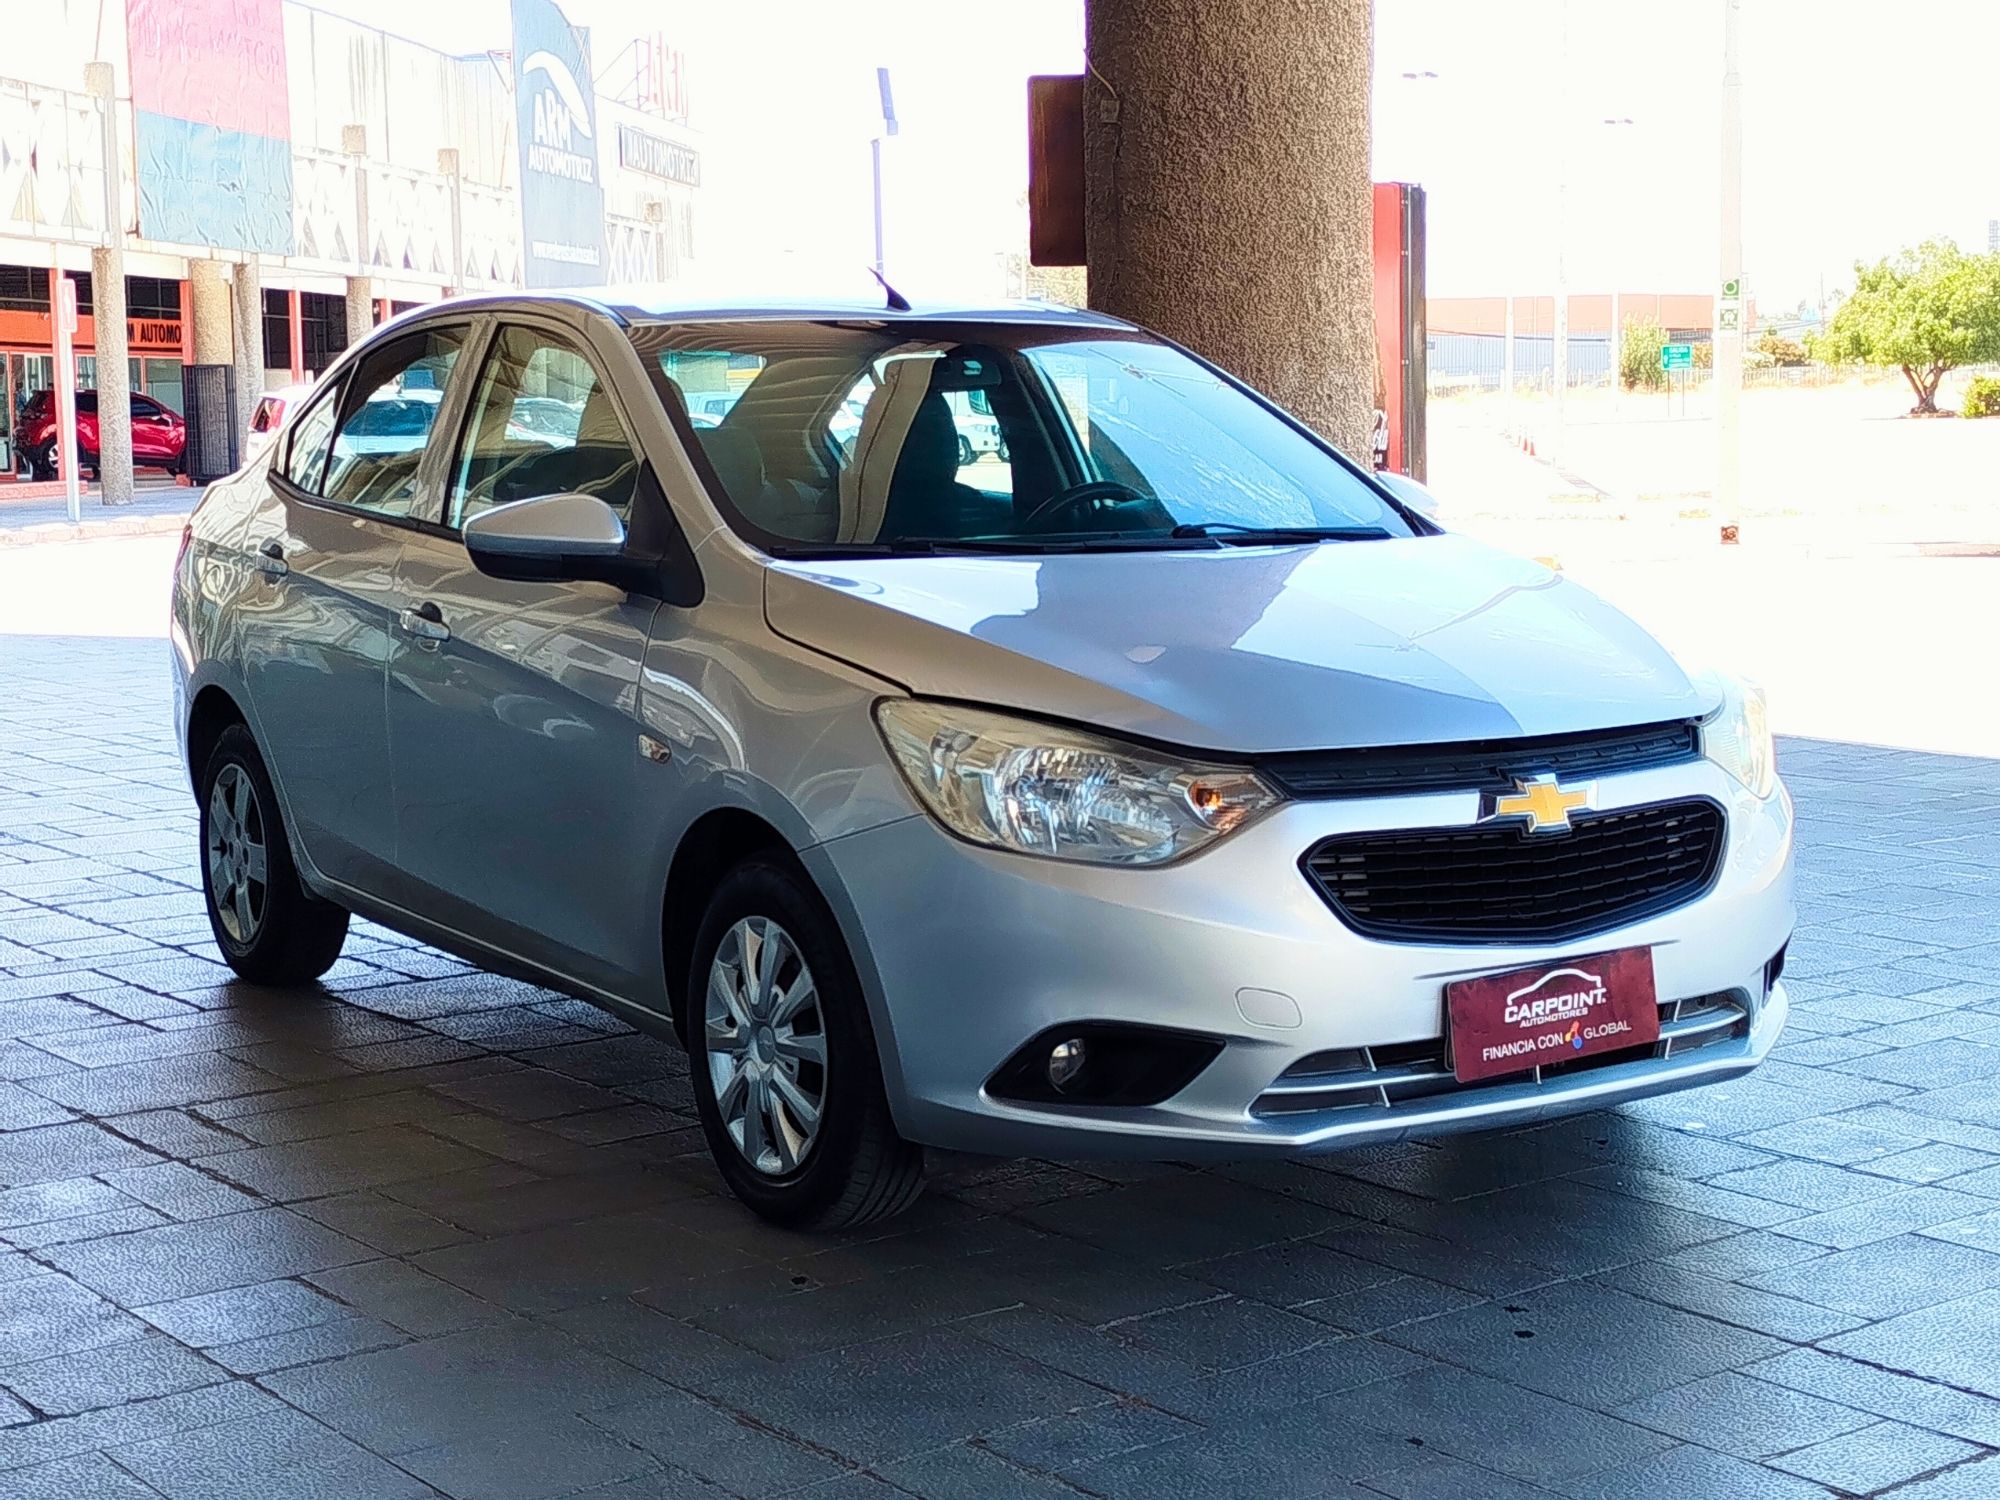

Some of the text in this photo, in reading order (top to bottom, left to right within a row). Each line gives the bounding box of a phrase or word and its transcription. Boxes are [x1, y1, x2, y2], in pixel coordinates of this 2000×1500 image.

[533, 87, 573, 151] ARM
[529, 144, 593, 183] AUTOMOTRIZ
[632, 132, 697, 184] AUTOMOTRIZ
[1519, 1007, 1588, 1028] AUTOMOTORES
[1483, 1020, 1632, 1061] FINANCIA CON GLOBAL
